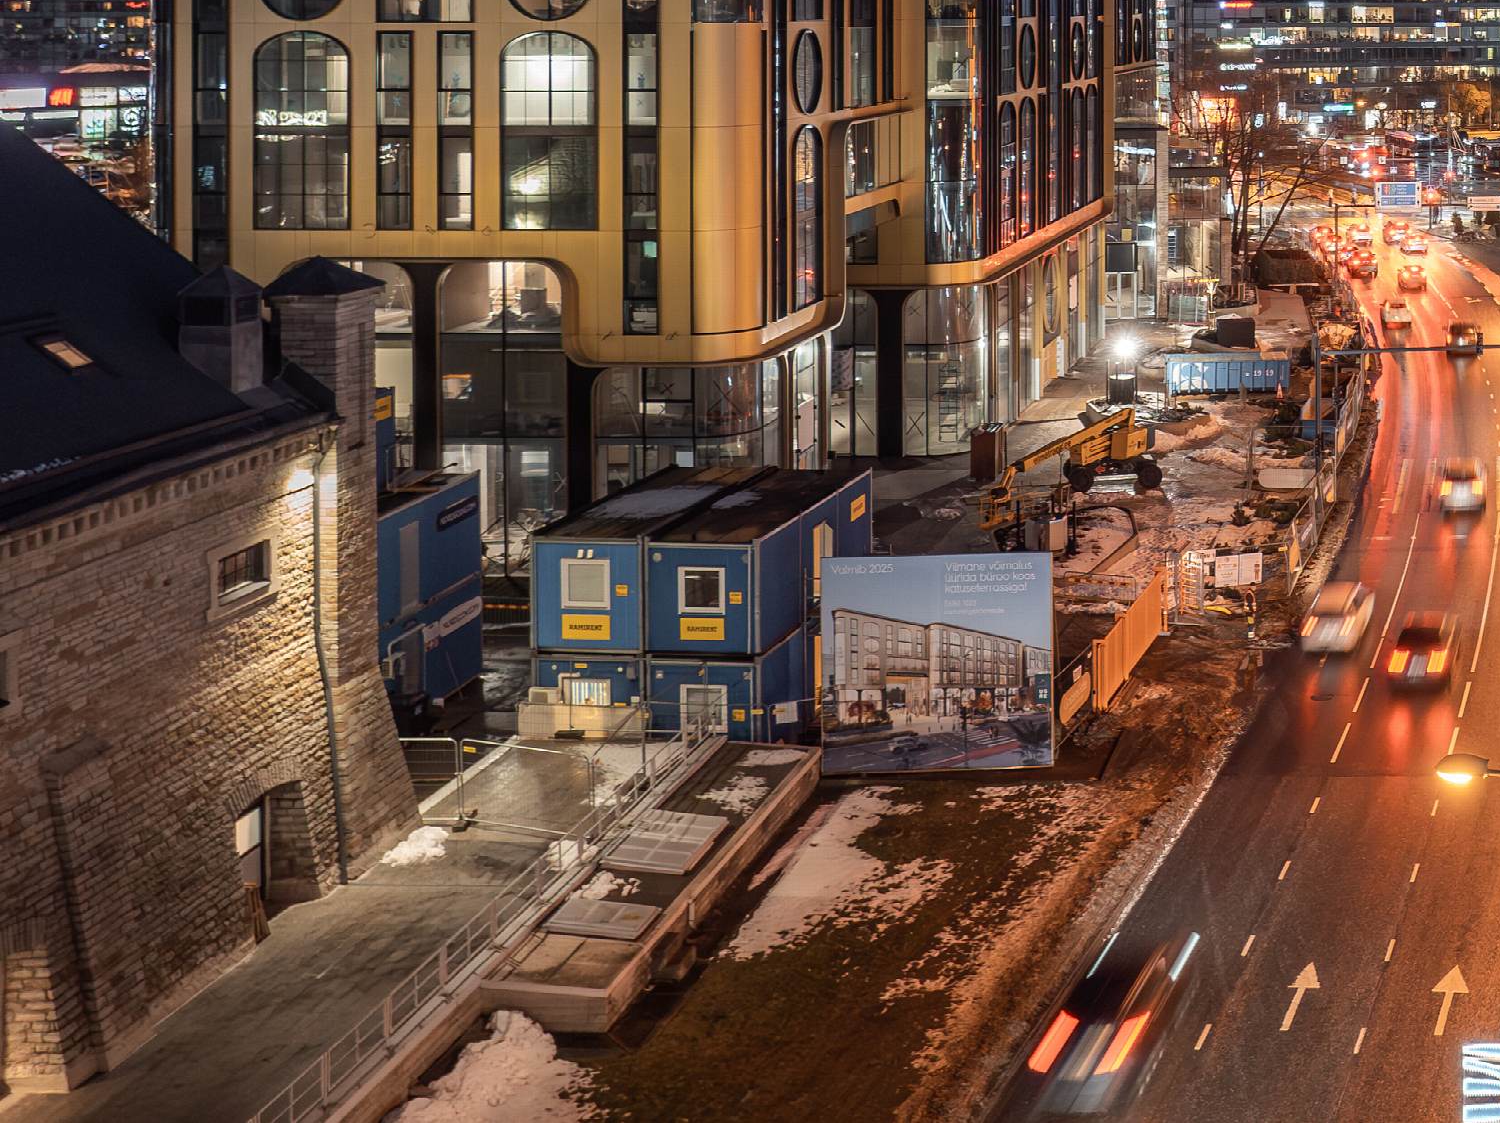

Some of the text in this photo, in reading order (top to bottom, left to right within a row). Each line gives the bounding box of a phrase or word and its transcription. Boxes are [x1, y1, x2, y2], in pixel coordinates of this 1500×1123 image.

[869, 563, 894, 573] 2025
[988, 560, 1033, 571] võimalus
[979, 572, 1010, 582] büroo
[1012, 571, 1036, 580] koos
